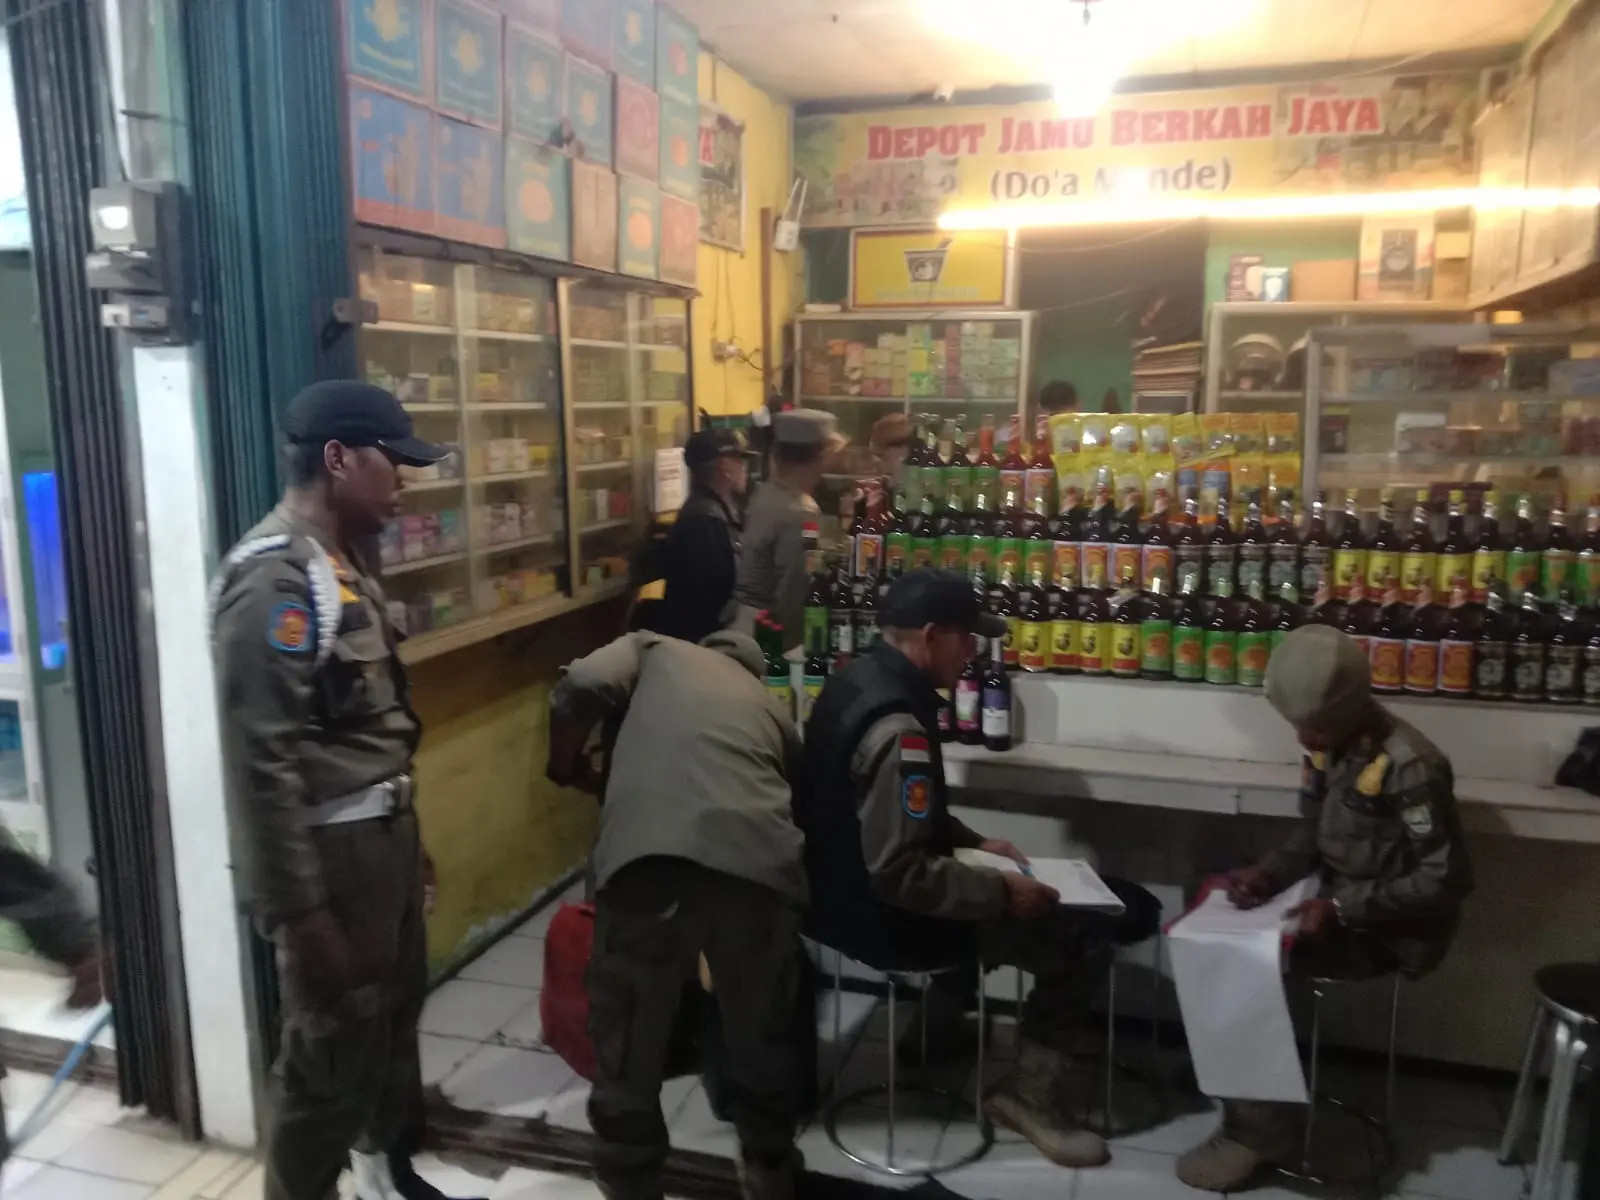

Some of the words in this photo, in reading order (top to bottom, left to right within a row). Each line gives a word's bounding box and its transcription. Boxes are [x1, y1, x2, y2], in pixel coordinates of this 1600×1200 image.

[867, 123, 986, 161] DEPOT
[997, 116, 1095, 153] JAMU
[1110, 105, 1271, 146] BERKAH
[1287, 97, 1381, 135] JAYA
[1093, 157, 1232, 193] Mnde)
